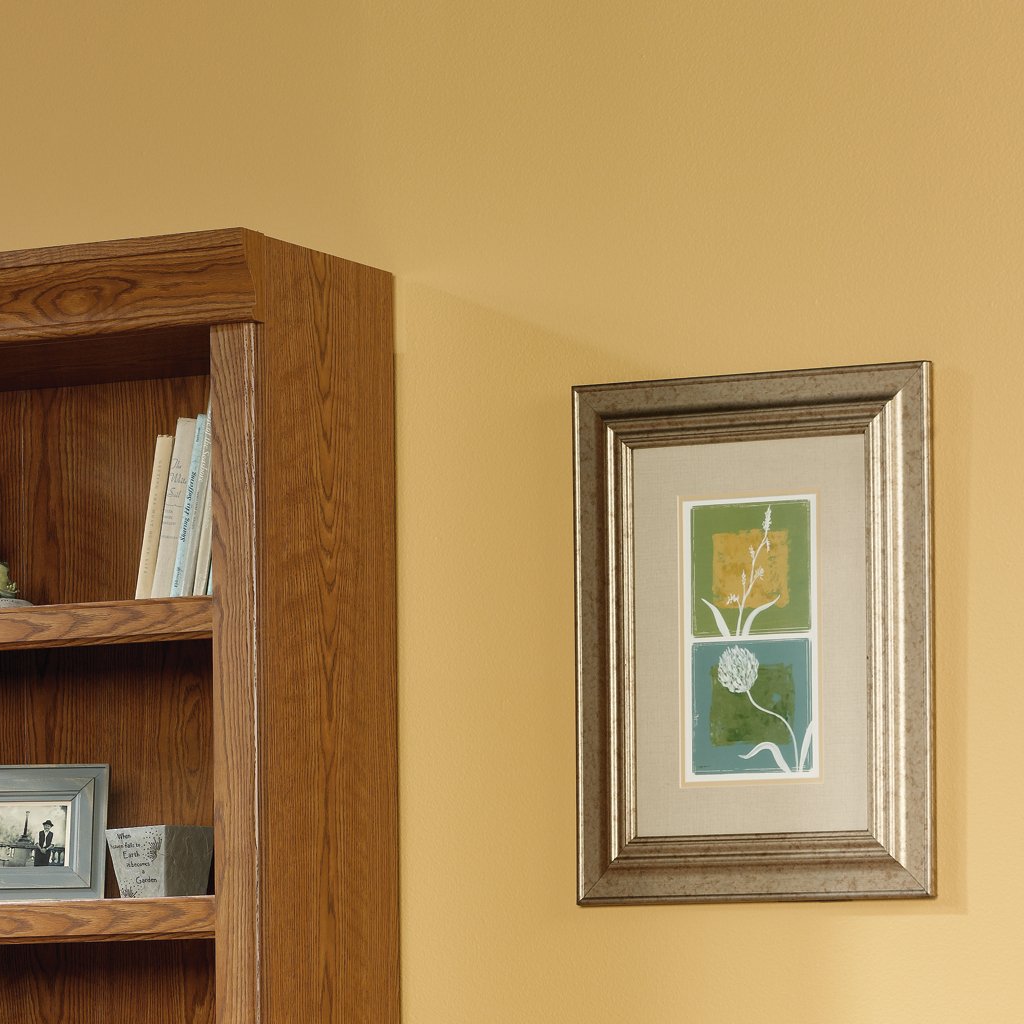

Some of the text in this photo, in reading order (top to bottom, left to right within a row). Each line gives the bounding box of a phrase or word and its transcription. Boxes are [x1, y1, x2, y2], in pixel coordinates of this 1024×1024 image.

[187, 471, 197, 501] Suffering
[184, 502, 192, 517] His
[180, 516, 190, 543] Sharing
[116, 832, 132, 840] When
[122, 851, 140, 859] Earth
[136, 876, 157, 884] Garden
